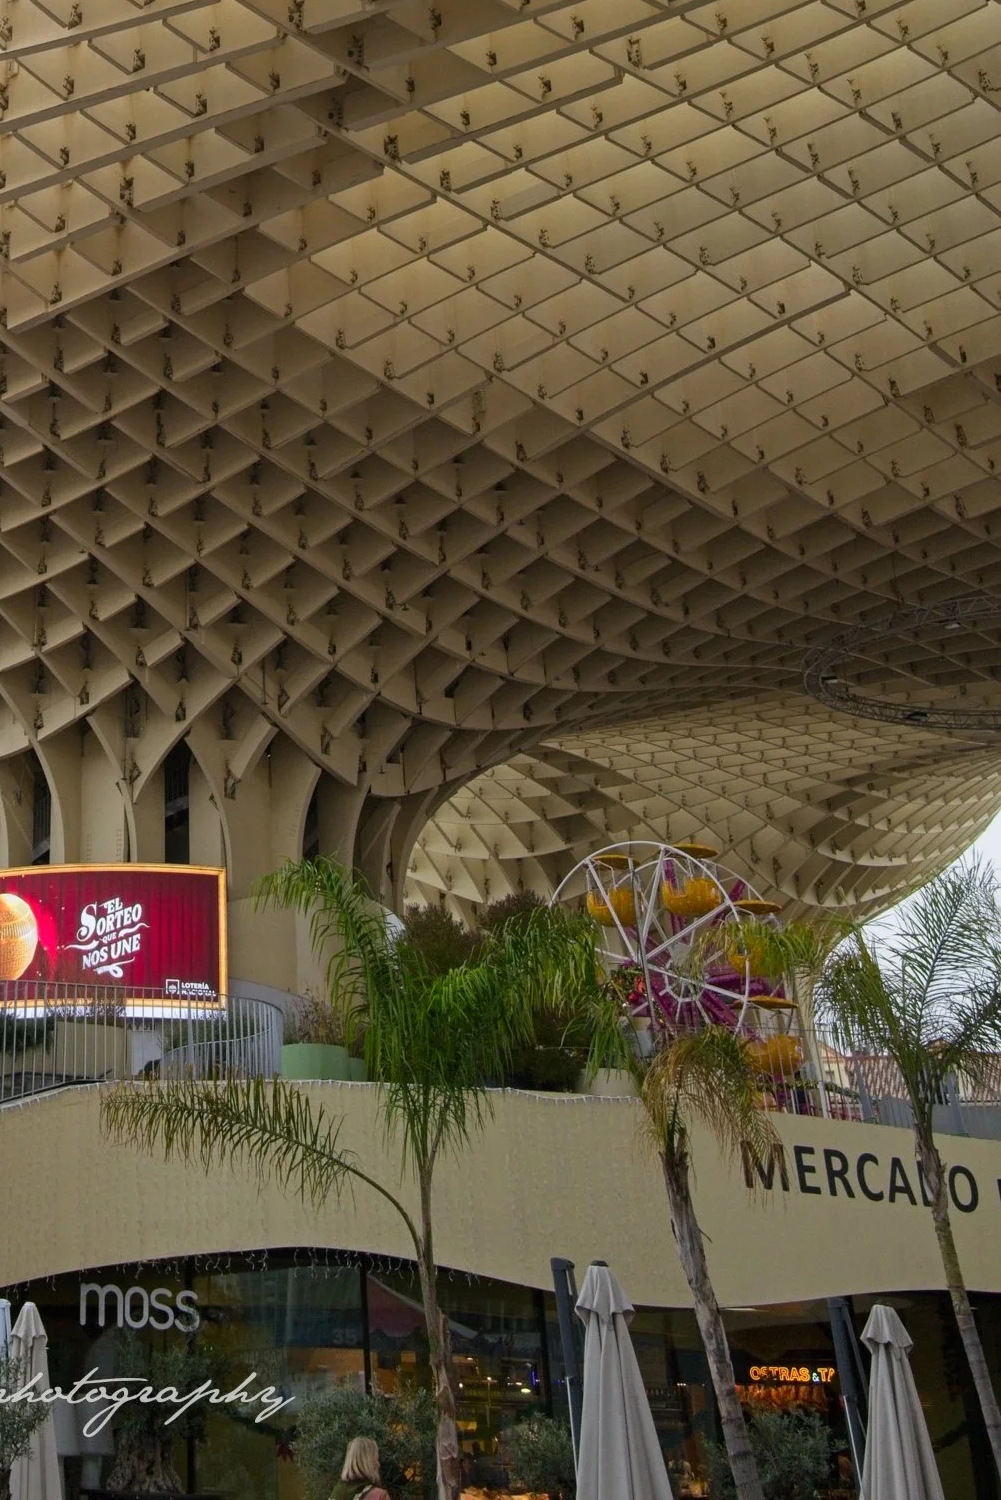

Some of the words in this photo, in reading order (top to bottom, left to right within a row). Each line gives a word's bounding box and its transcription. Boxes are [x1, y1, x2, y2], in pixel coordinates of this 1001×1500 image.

[99, 897, 123, 914] EL
[77, 902, 142, 942] SORTEO
[100, 932, 117, 944] QUE
[83, 946, 108, 970] NOS
[111, 933, 141, 959] UNE
[181, 982, 209, 990] LOTERÍA
[79, 1283, 200, 1333] moss
[749, 1365, 811, 1382] OSTRAS
[811, 1372, 820, 1382] &
